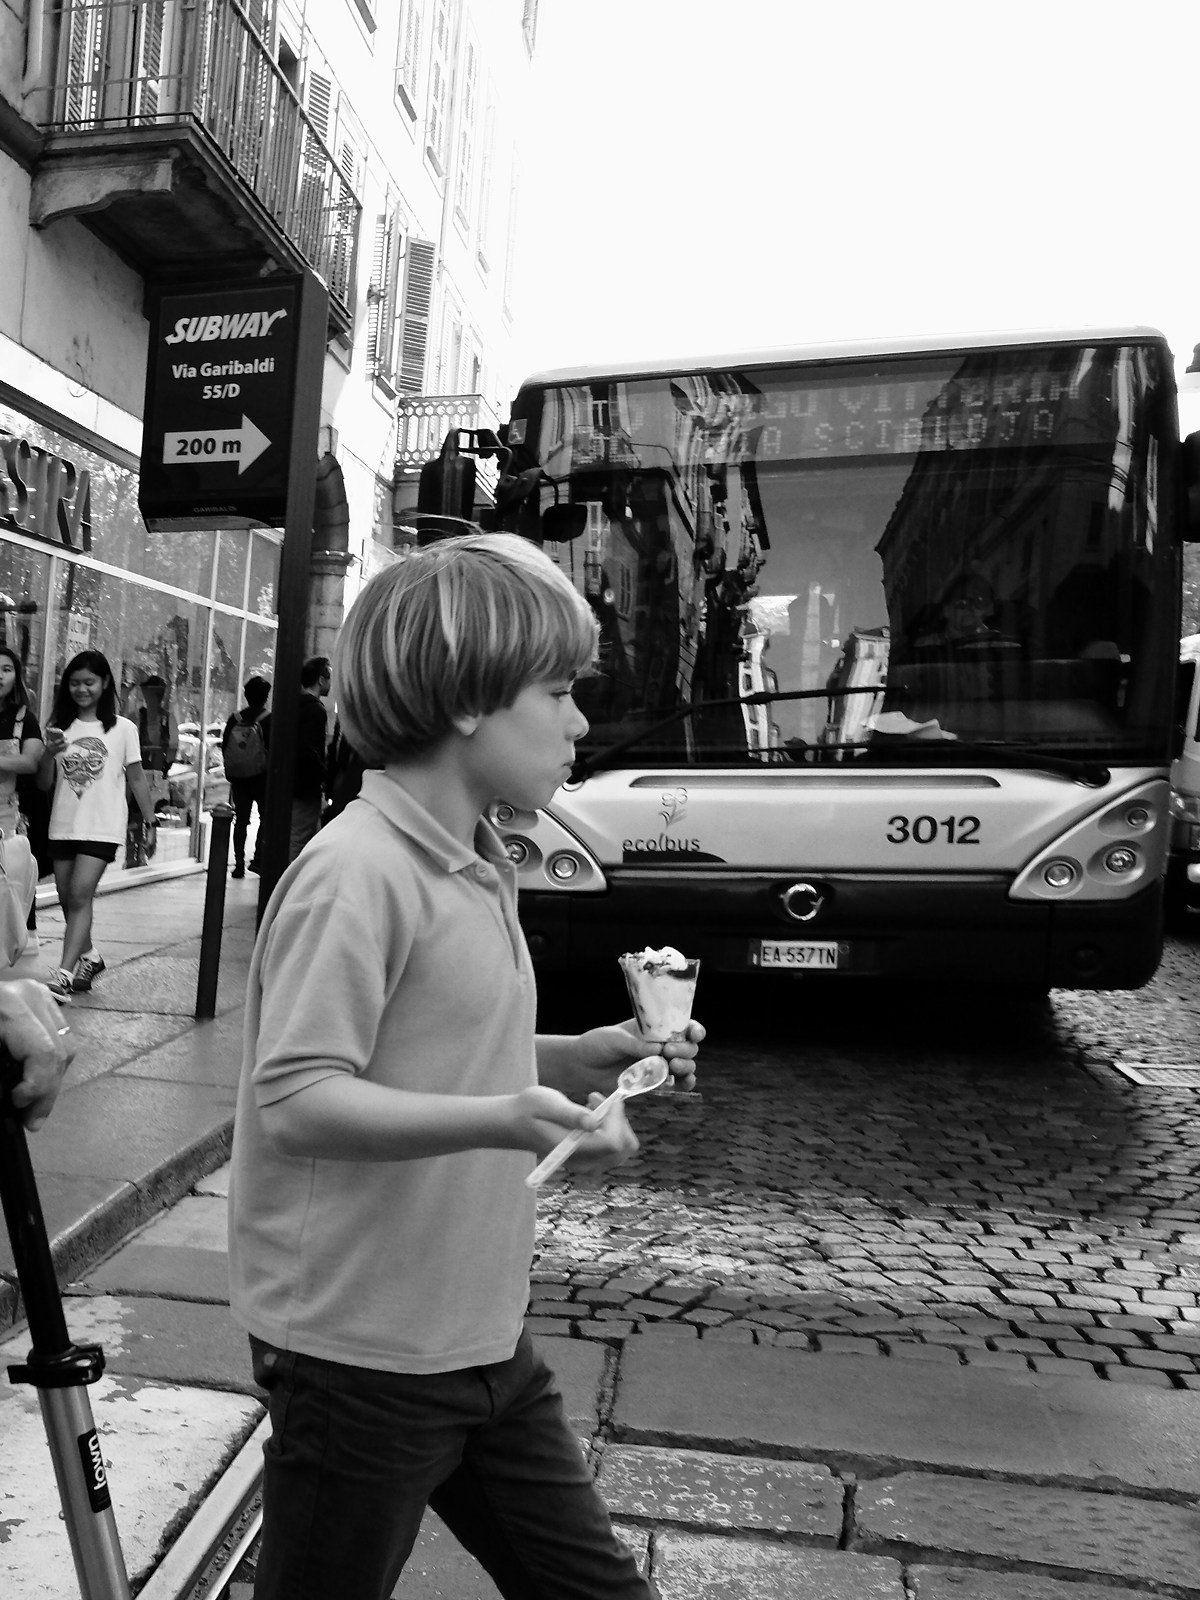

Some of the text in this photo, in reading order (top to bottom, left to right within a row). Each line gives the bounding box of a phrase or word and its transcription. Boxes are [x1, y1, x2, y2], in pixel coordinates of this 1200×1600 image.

[165, 308, 287, 345] SUBWAY
[171, 357, 275, 379] Via Garibaldi
[202, 383, 240, 399] 55/D
[176, 438, 241, 456] 200 m
[886, 815, 981, 844] 3012
